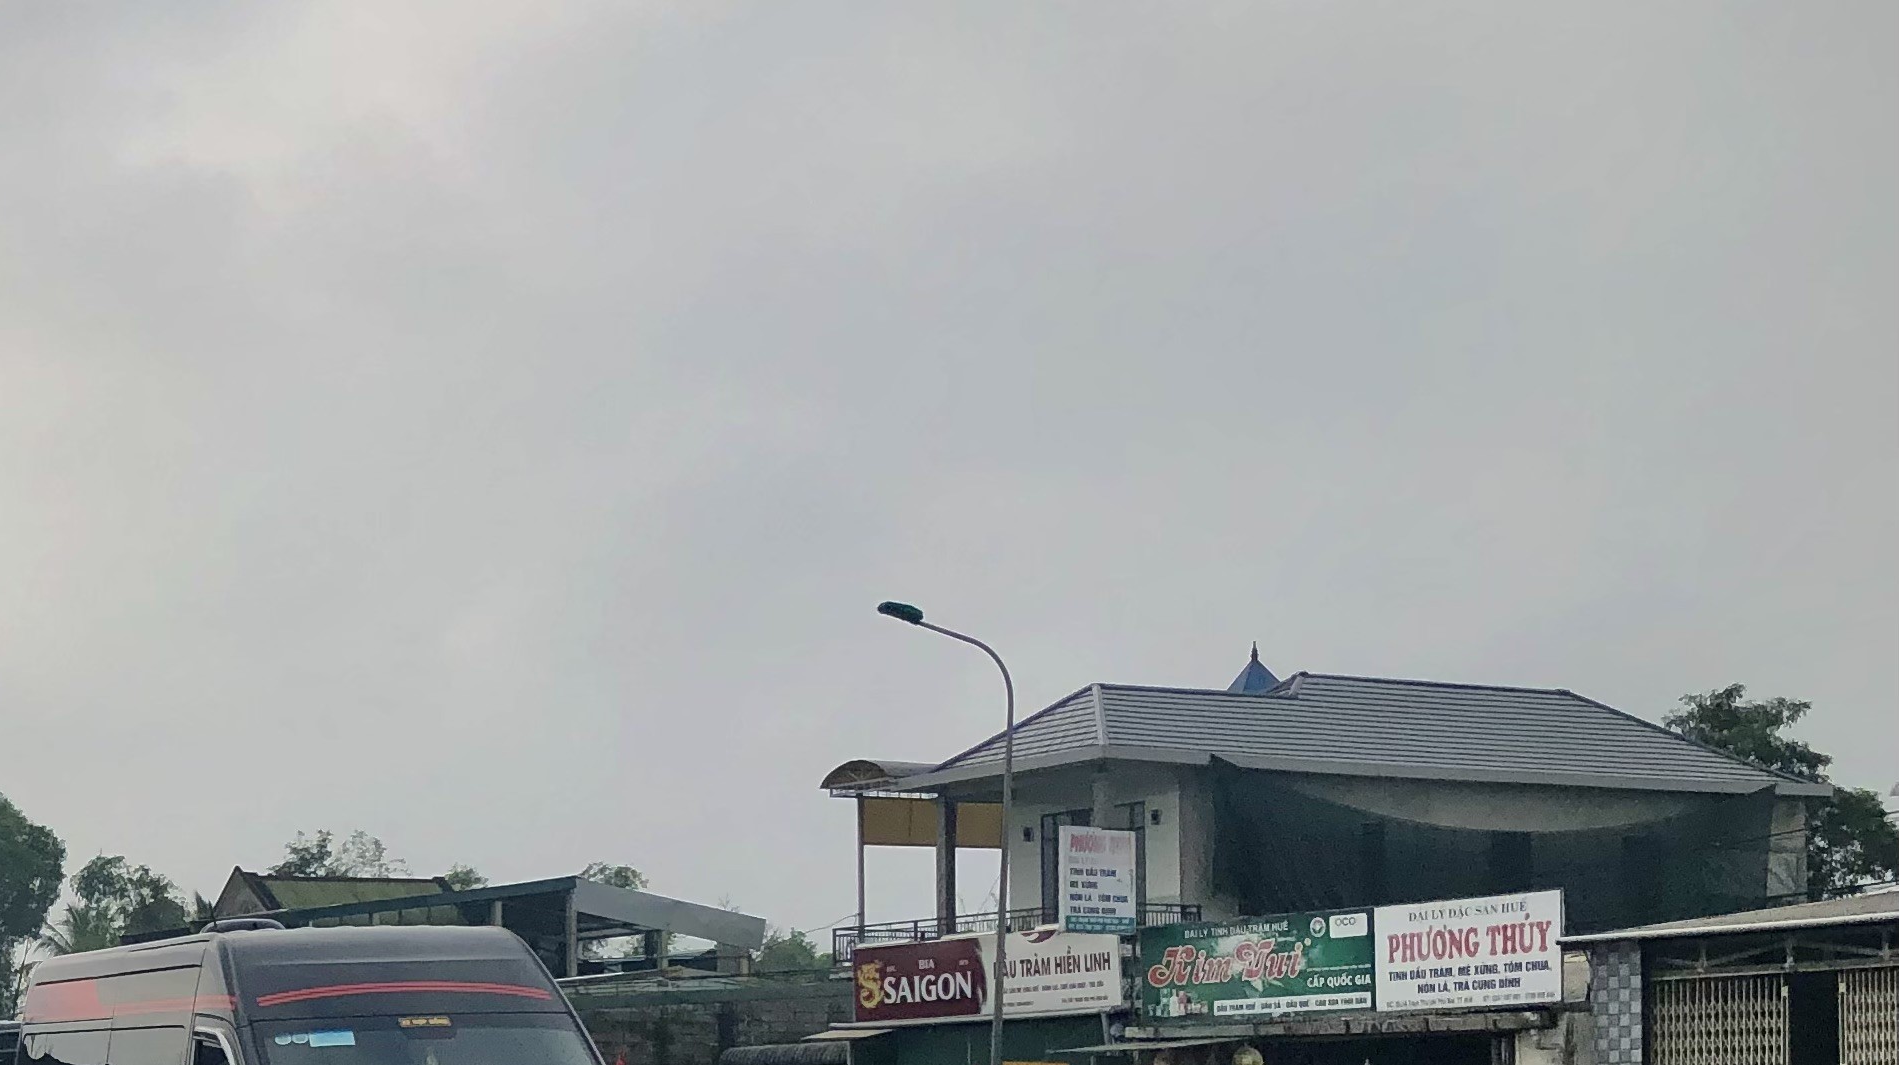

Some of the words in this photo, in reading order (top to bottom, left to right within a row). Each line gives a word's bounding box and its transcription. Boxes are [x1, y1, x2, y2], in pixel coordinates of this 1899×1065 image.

[1387, 923, 1480, 964] PHƯƠNG
[918, 959, 935, 970] BIA
[1020, 952, 1051, 978] TRÀM
[1084, 951, 1111, 973] LINH
[1148, 944, 1232, 987] Kim
[1306, 973, 1325, 988] CẤP
[1327, 971, 1353, 988] QUỐC
[1354, 974, 1372, 985] GIA
[884, 970, 972, 1004] SAIGON
